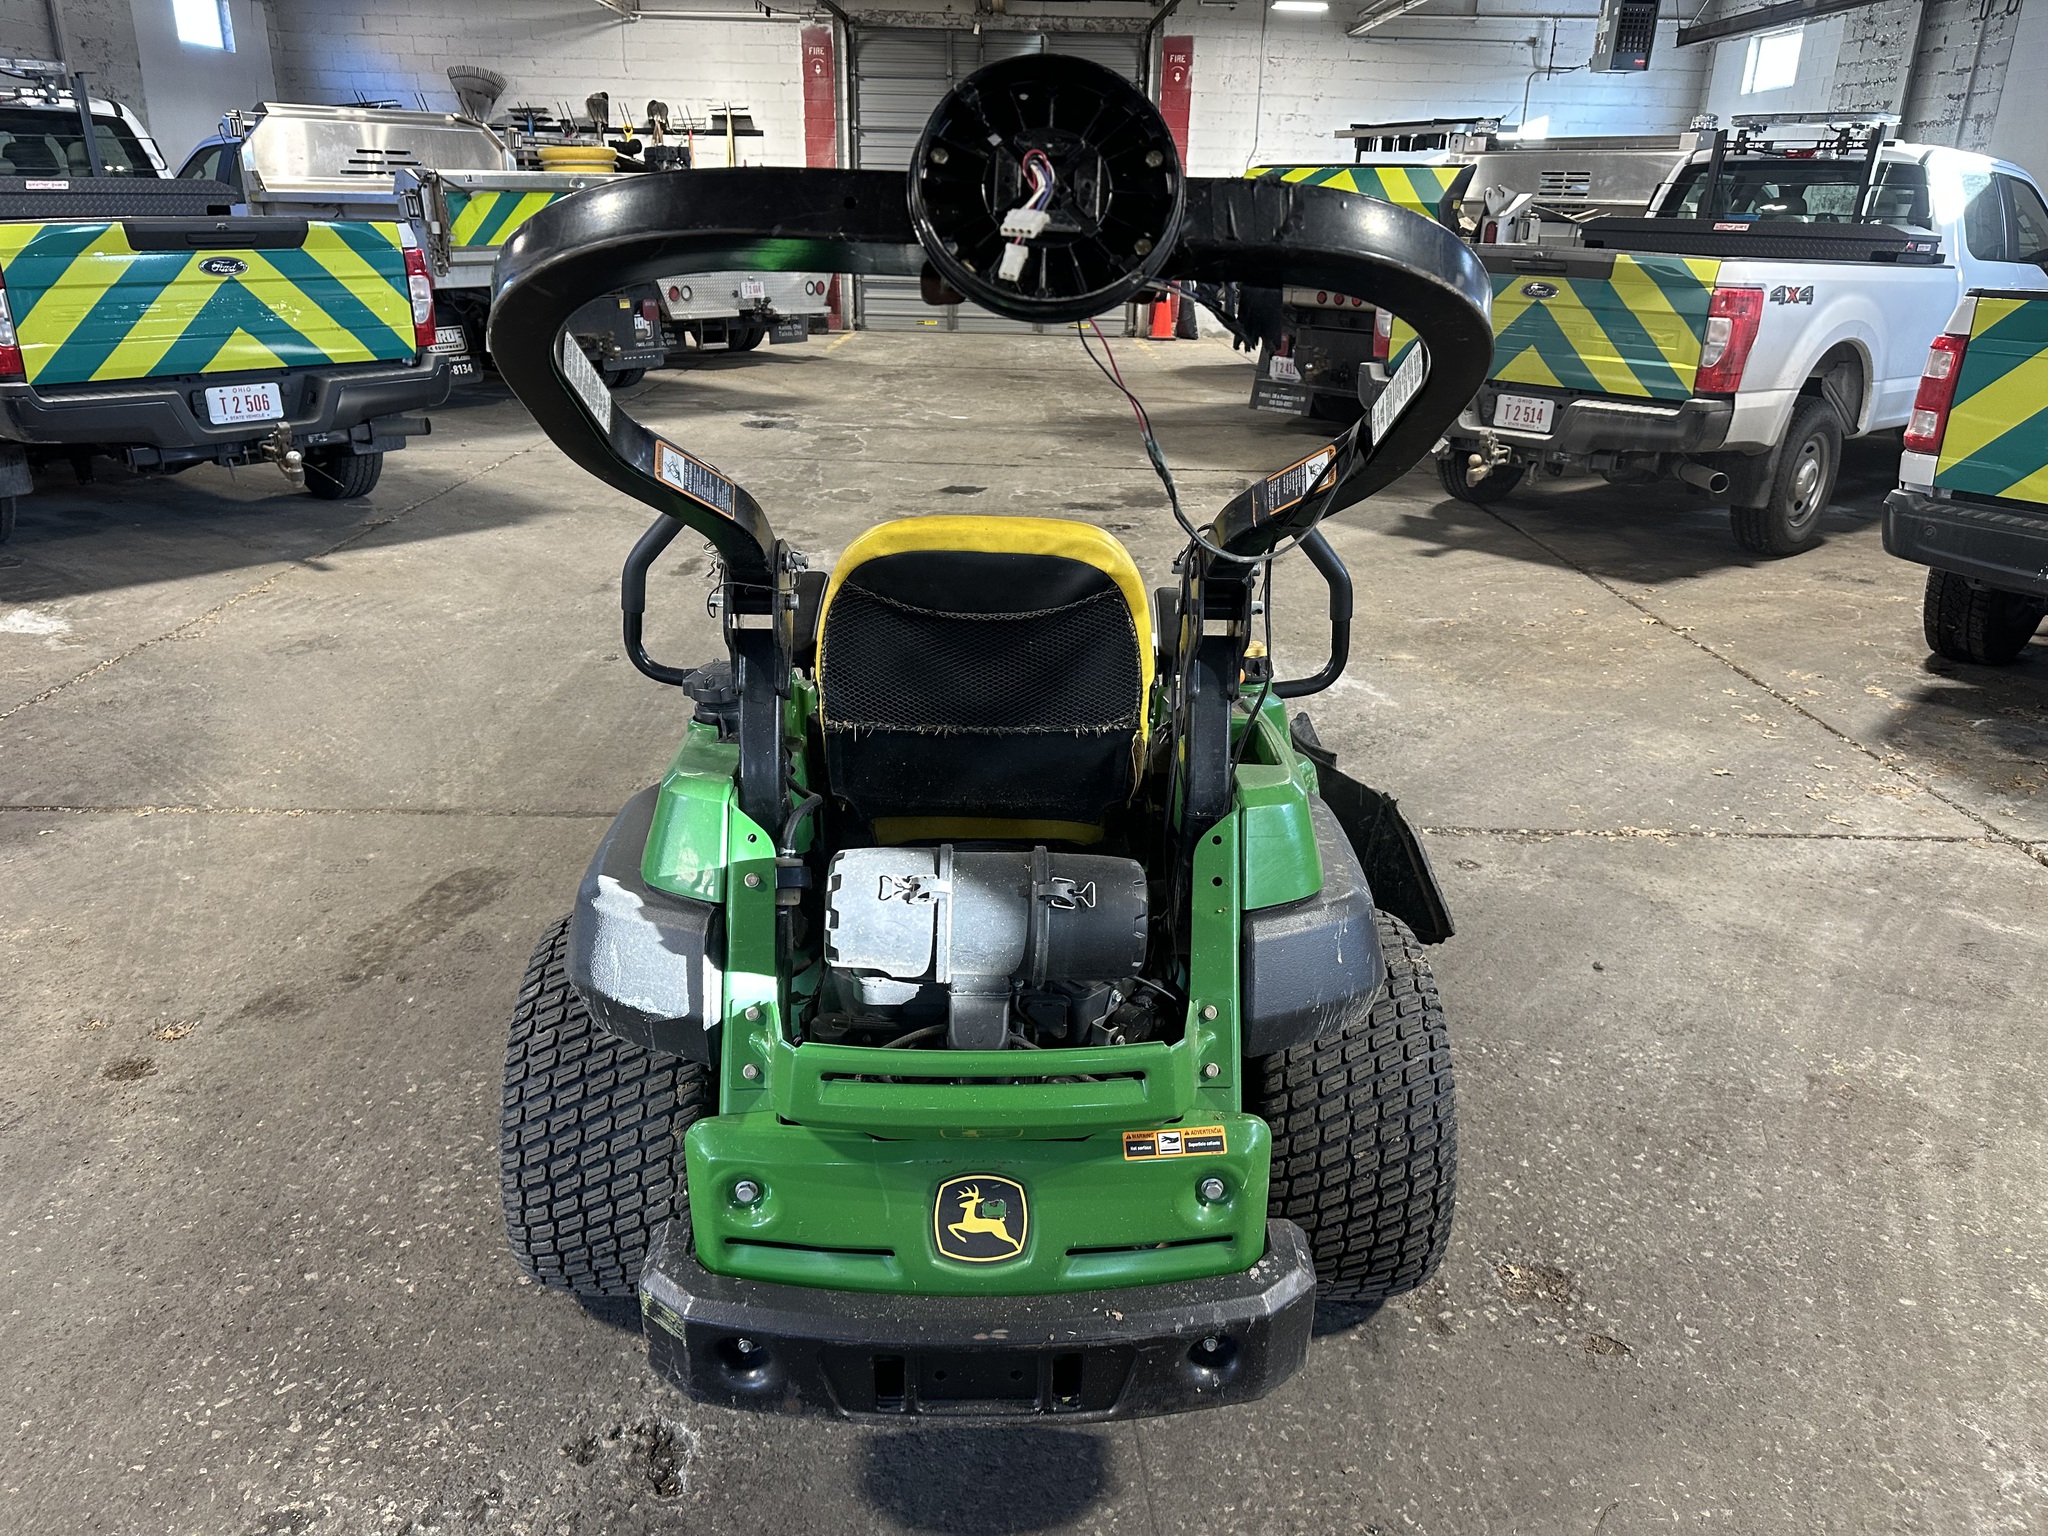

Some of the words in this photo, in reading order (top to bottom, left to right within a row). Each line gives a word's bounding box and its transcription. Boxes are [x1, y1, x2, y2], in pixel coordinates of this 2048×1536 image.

[808, 46, 825, 56] FIRE
[1169, 54, 1186, 63] FIRE
[20, 88, 73, 97] RAK
[219, 397, 227, 415] T
[233, 396, 241, 414] 2
[245, 394, 270, 412] 506
[1505, 404, 1511, 420] T
[1513, 406, 1521, 421] 2
[1523, 407, 1543, 424] 514
